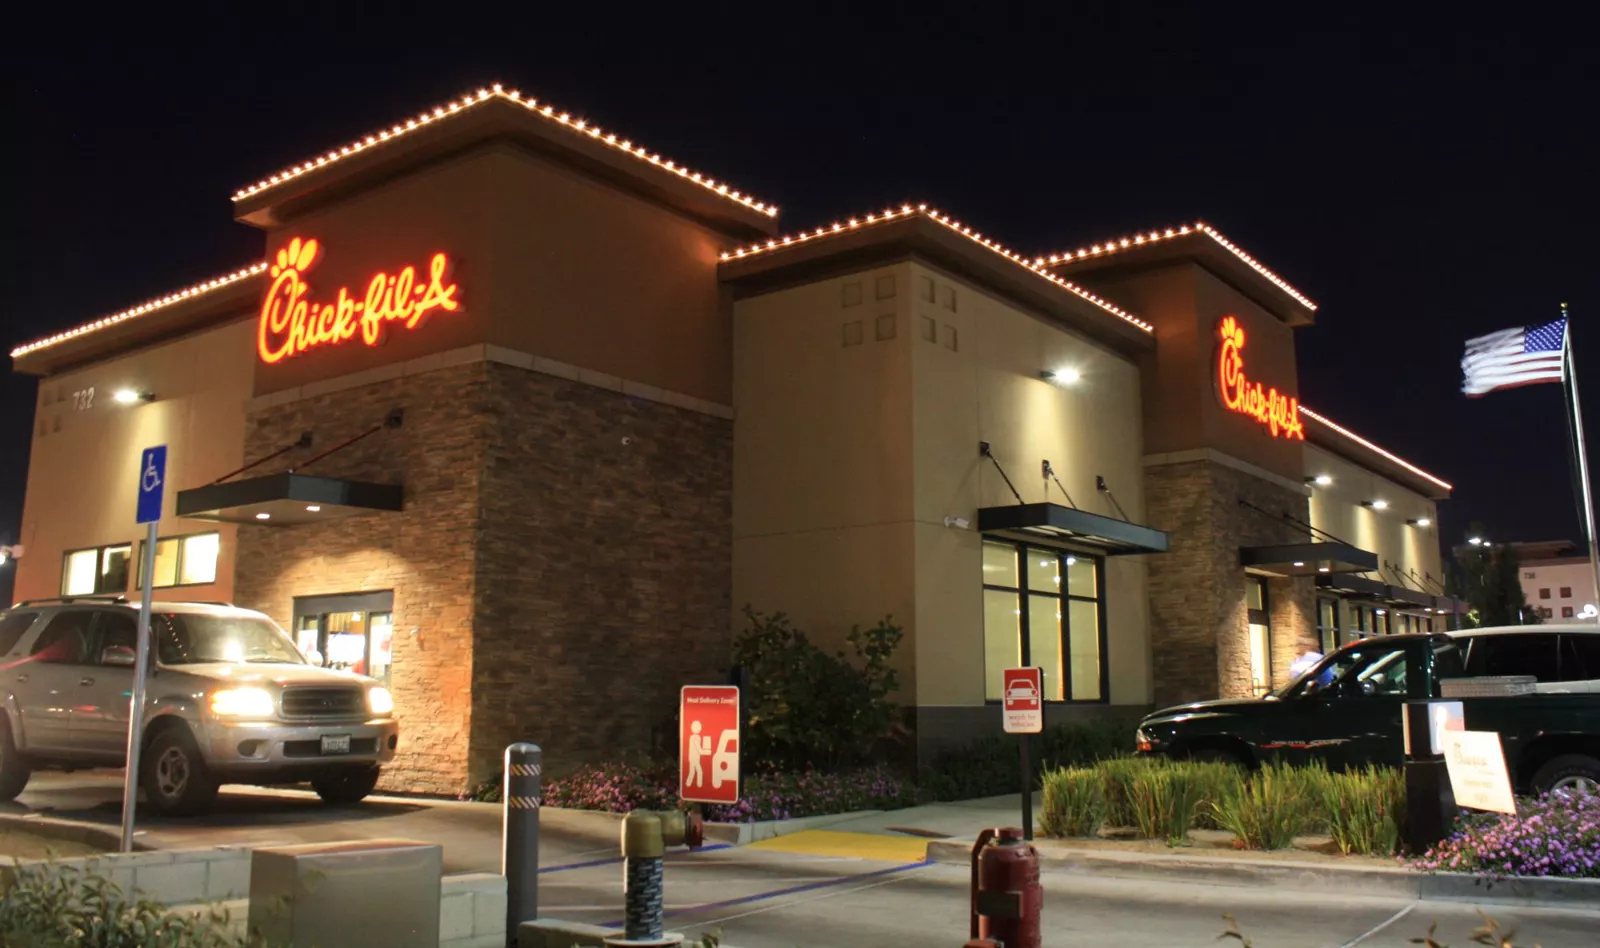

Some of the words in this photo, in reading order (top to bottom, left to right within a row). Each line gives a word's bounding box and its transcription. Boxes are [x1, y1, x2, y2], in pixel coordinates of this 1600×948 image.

[259, 237, 458, 364] Chick-fil-A
[73, 387, 95, 411] 732
[1219, 316, 1304, 441] Chick-fil-A
[700, 696, 720, 705] Delivery
